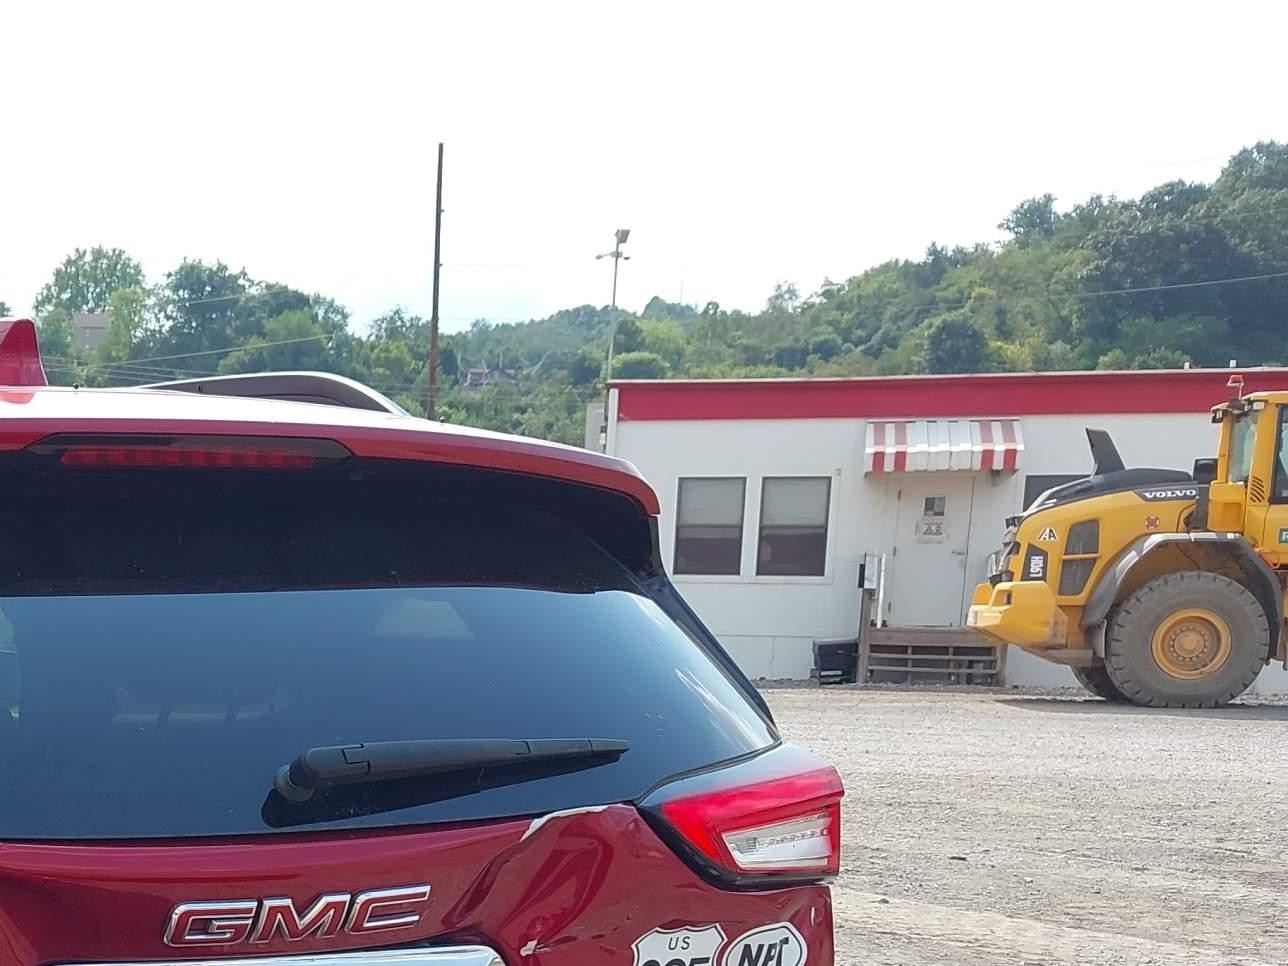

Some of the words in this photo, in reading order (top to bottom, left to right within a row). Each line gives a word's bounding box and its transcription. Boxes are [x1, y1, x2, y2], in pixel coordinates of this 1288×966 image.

[1143, 489, 1197, 499] VOLVO
[1030, 556, 1044, 577] L90H
[165, 884, 431, 947] GMC
[668, 936, 690, 950] US
